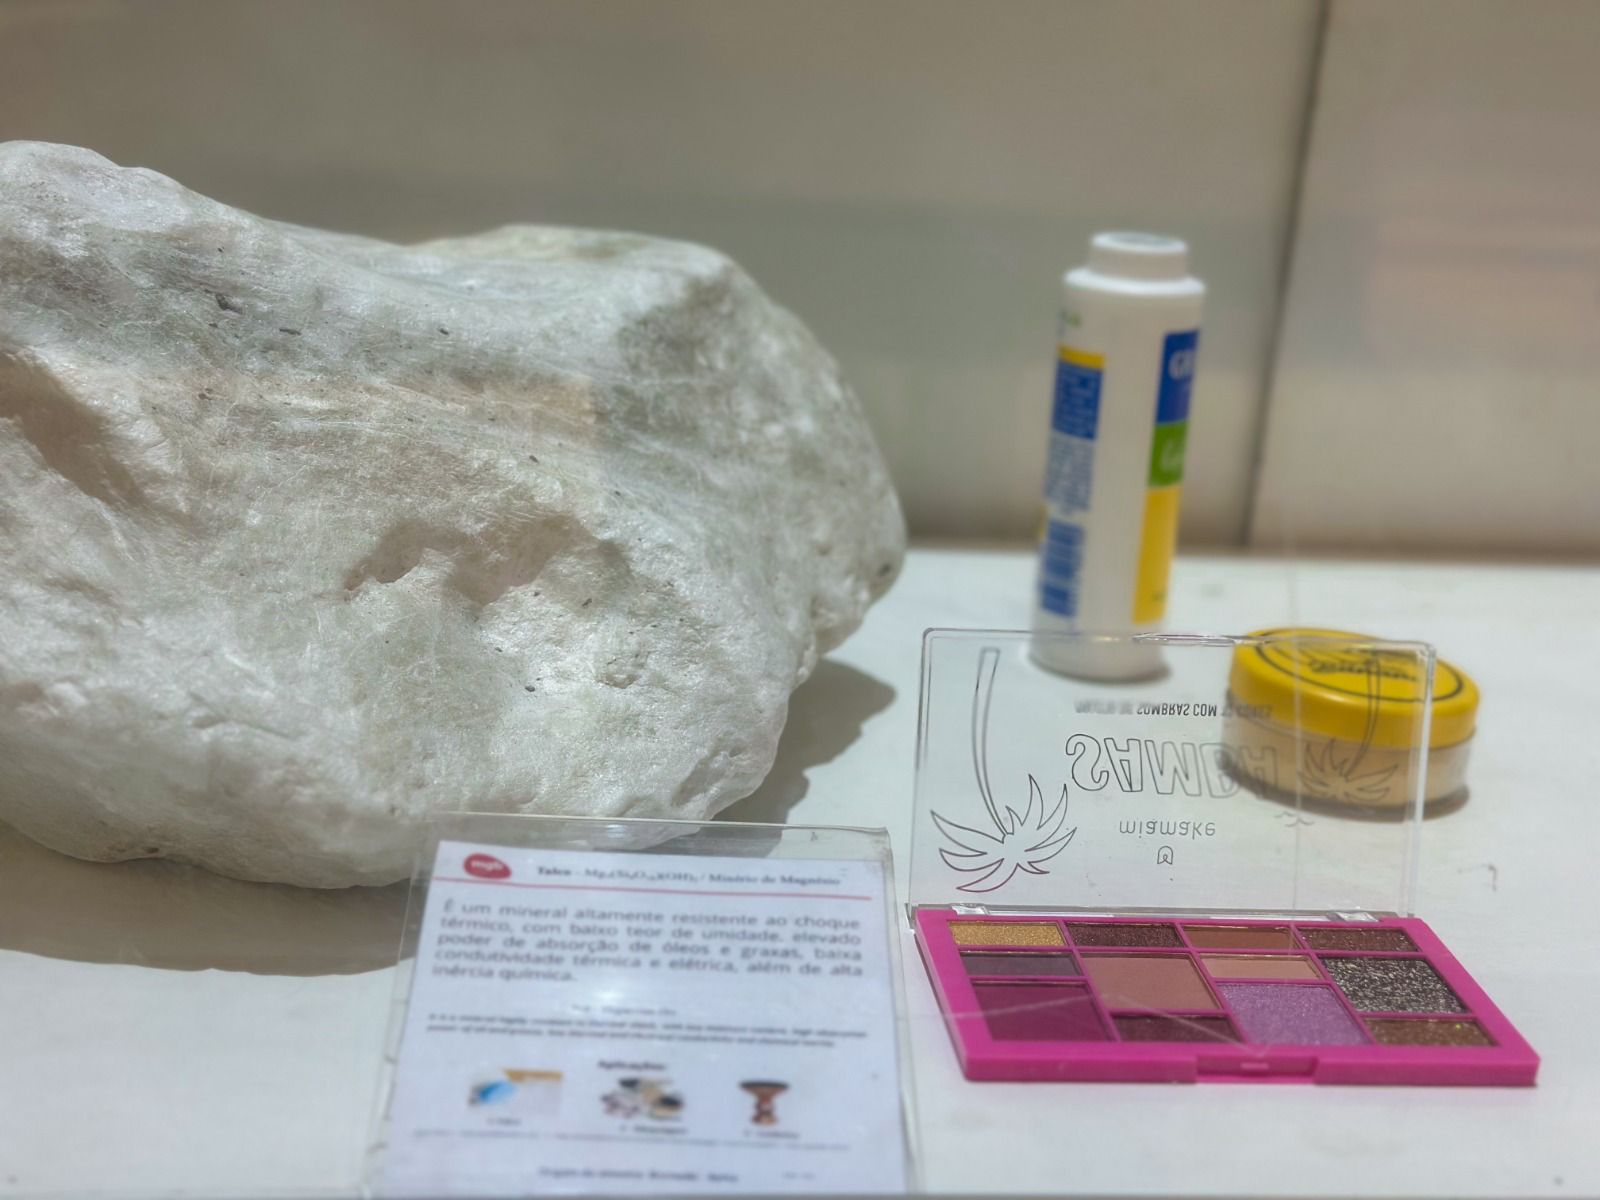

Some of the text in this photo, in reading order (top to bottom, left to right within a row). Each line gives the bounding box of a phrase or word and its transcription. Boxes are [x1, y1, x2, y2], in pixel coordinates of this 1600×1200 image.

[536, 866, 572, 876] Talco
[761, 874, 777, 885] de
[462, 904, 492, 914] um
[499, 905, 568, 919] mineral
[574, 907, 665, 923] altamente
[671, 912, 759, 926] resistente
[765, 915, 788, 927] ao
[794, 914, 861, 931] choque
[522, 923, 562, 935] com
[569, 923, 619, 938] baixo
[626, 925, 663, 939] teor
[671, 926, 695, 940] de
[792, 931, 862, 947] elevado
[437, 933, 493, 949] poder
[502, 935, 526, 949] de
[536, 937, 619, 954] absorção
[628, 940, 653, 954] de
[662, 940, 711, 956] óleos
[720, 945, 732, 957] e
[813, 946, 863, 963] baixa
[431, 963, 495, 980] inércia
[434, 948, 566, 967] condutividade
[572, 954, 642, 969] térmica
[649, 959, 662, 970] e
[746, 959, 792, 976] além
[798, 961, 823, 977] de
[829, 962, 864, 979] alta
